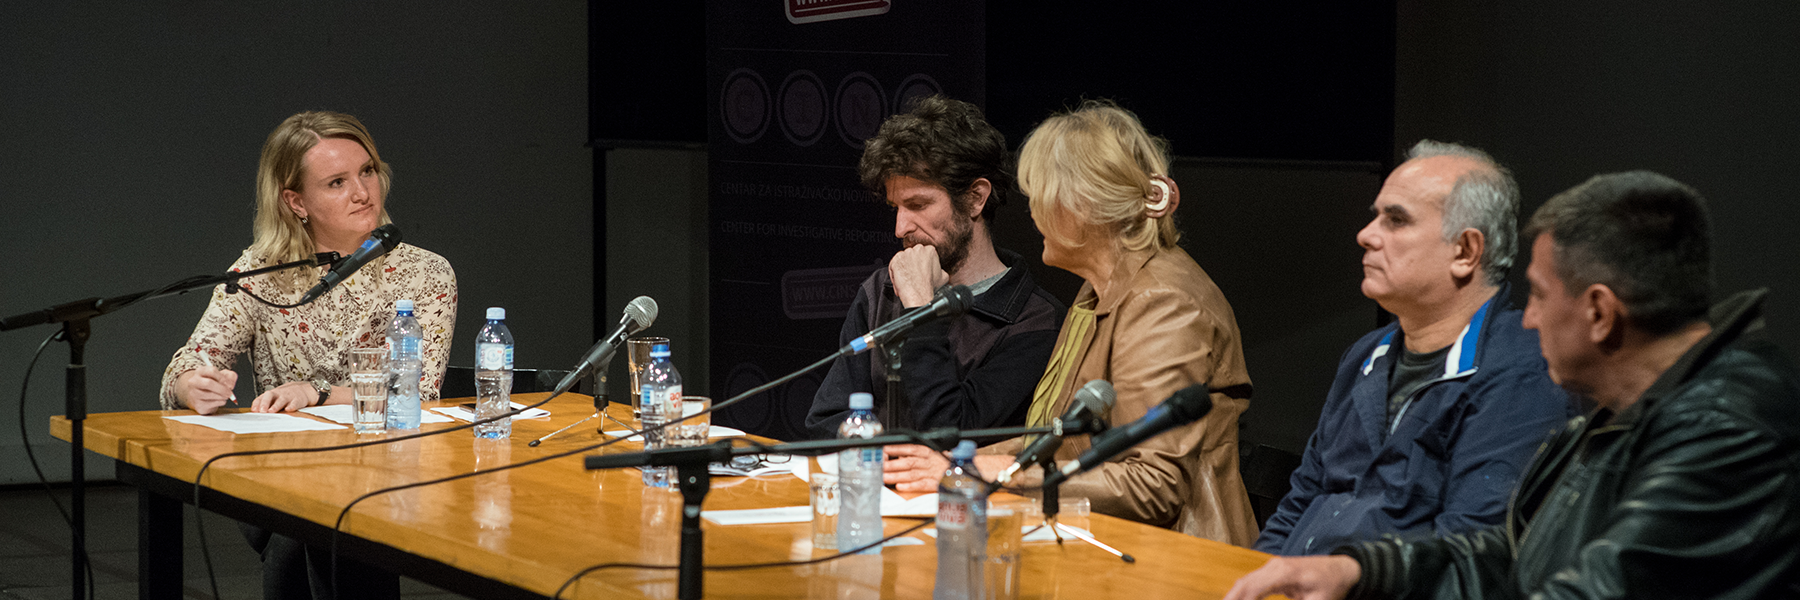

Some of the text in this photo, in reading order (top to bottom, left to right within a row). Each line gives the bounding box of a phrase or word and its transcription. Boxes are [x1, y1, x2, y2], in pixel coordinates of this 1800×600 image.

[720, 182, 756, 196] CENTAR
[758, 184, 771, 197] ZA
[720, 221, 899, 245] CENTER FOR INVESTIGATIVE REPORTING
[791, 284, 855, 302] WWW.CINS
